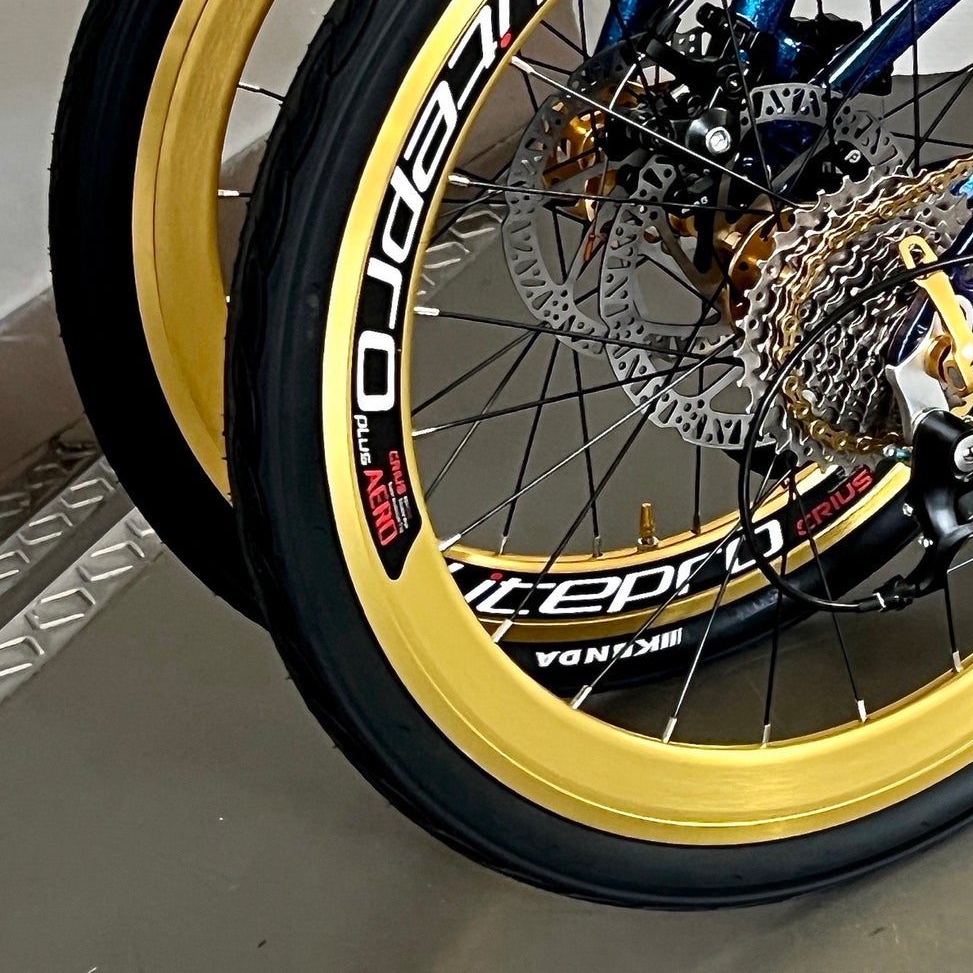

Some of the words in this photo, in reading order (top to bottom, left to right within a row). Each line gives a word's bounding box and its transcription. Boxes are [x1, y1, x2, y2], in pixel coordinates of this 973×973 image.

[363, 469, 398, 546] AERO
[797, 468, 873, 536] CRIUS
[447, 518, 784, 615] itepro
